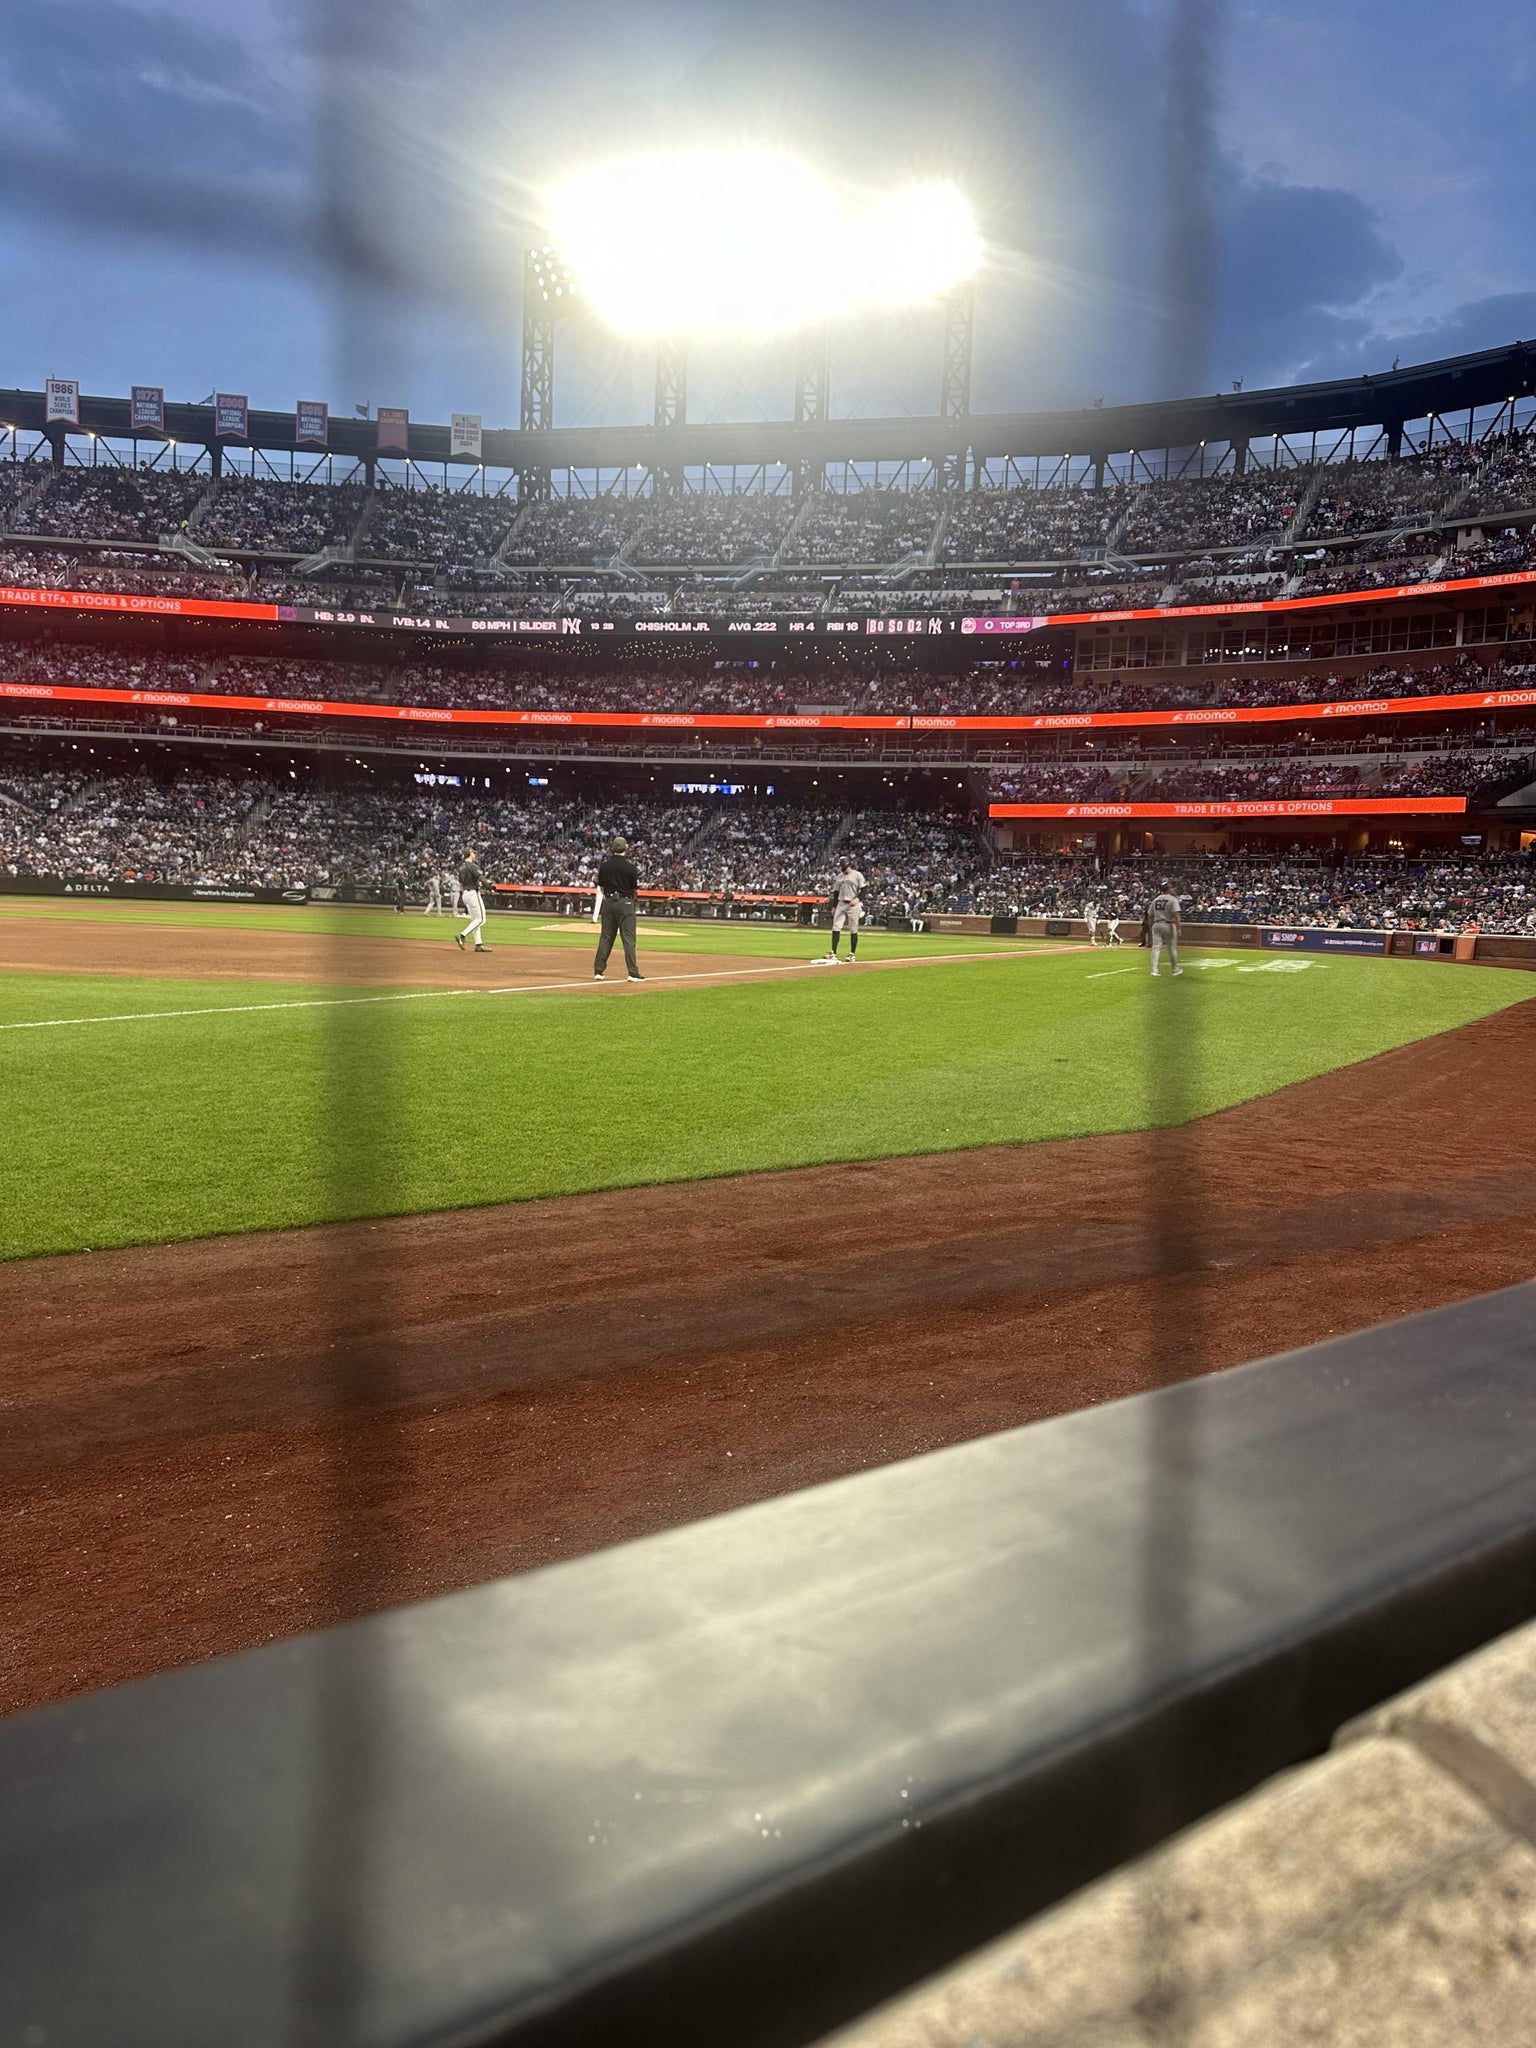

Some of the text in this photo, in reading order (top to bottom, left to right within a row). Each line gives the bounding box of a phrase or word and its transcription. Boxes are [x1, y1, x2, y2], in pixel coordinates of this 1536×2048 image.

[51, 384, 74, 394] 1986
[136, 390, 160, 401] 1973
[220, 396, 244, 408] 2000
[1407, 583, 1447, 594] moomoo
[1, 590, 37, 602] TRADE
[72, 594, 118, 606] STOCKS
[120, 598, 128, 607] &
[130, 598, 182, 610] OPTIONS
[1232, 602, 1263, 612] OPTIONS
[314, 610, 334, 621] HB:
[360, 614, 375, 624] IN.
[392, 616, 450, 630] IVB: 1.4 IN.
[472, 620, 486, 630] 86
[487, 621, 511, 630] MPH
[520, 621, 557, 630] SLIDER
[590, 622, 600, 630] 13
[602, 622, 614, 630] 2B
[634, 622, 692, 631] CHISHOLM
[692, 622, 710, 632] JR.
[728, 622, 752, 631] AVG
[752, 622, 777, 632] .222
[789, 622, 804, 631] HR
[806, 622, 815, 632] 4
[826, 622, 844, 631] RBI
[846, 622, 859, 632] 16
[949, 621, 956, 630] 1
[6, 686, 54, 696] moomoo
[144, 694, 190, 704] moomoo
[278, 702, 324, 712] moomoo
[1336, 702, 1388, 714] moomoo
[410, 710, 452, 720] moomoo
[531, 714, 572, 722] moomoo
[652, 716, 694, 724] moomoo
[1186, 712, 1236, 720] moomoo
[776, 718, 820, 726] moomoo
[1045, 716, 1092, 726] moomoo
[1080, 806, 1132, 815] moomoo
[1174, 805, 1206, 814] TRADE
[1236, 804, 1275, 812] STOCKS
[1278, 804, 1284, 812] &
[1287, 802, 1333, 812] OPTIONS
[76, 884, 110, 892] DELTA
[1155, 900, 1168, 910] 67
[1282, 932, 1298, 942] SHOP
